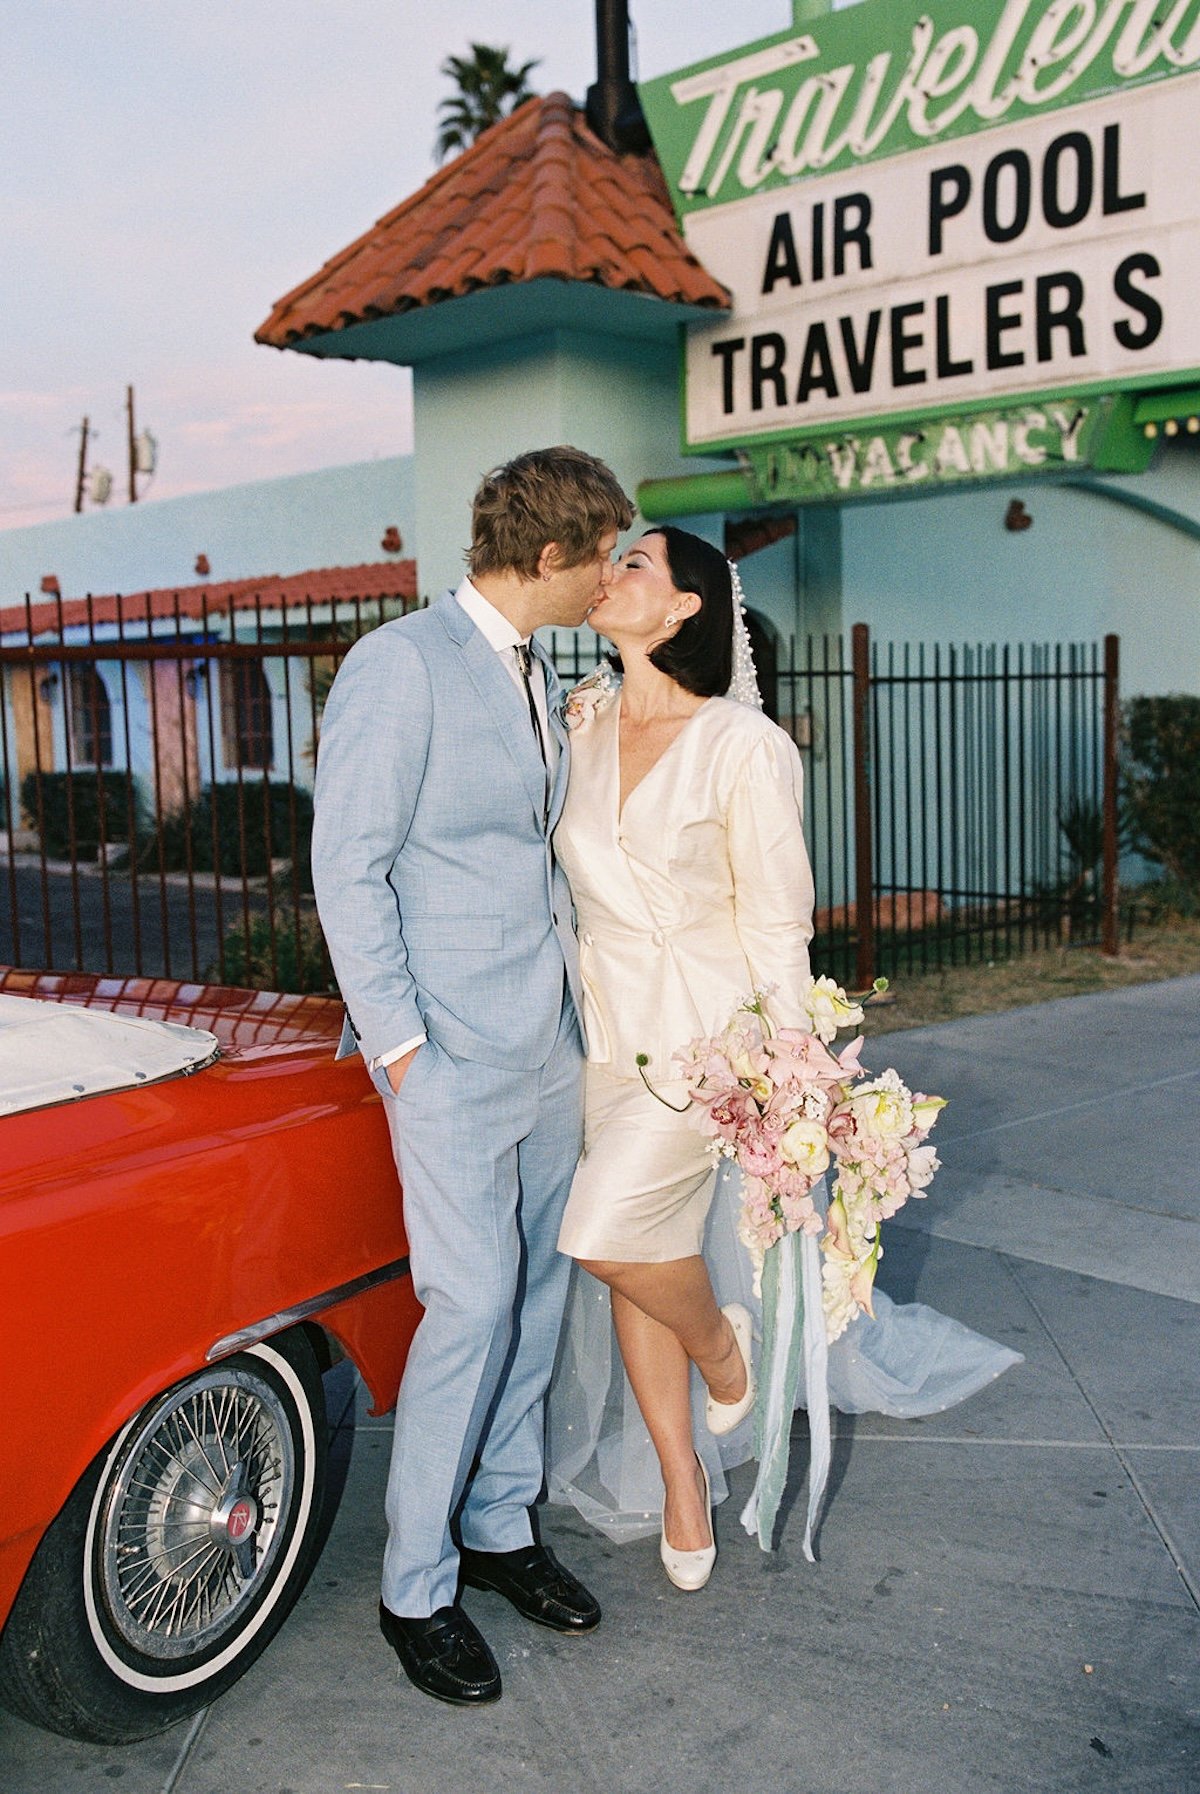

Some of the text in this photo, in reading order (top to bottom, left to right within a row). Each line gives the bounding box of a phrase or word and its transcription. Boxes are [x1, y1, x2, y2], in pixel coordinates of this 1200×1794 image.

[761, 123, 1146, 295] AIR POOL
[710, 253, 1163, 415] TRAVELERS
[827, 408, 1088, 489] VACANCY
